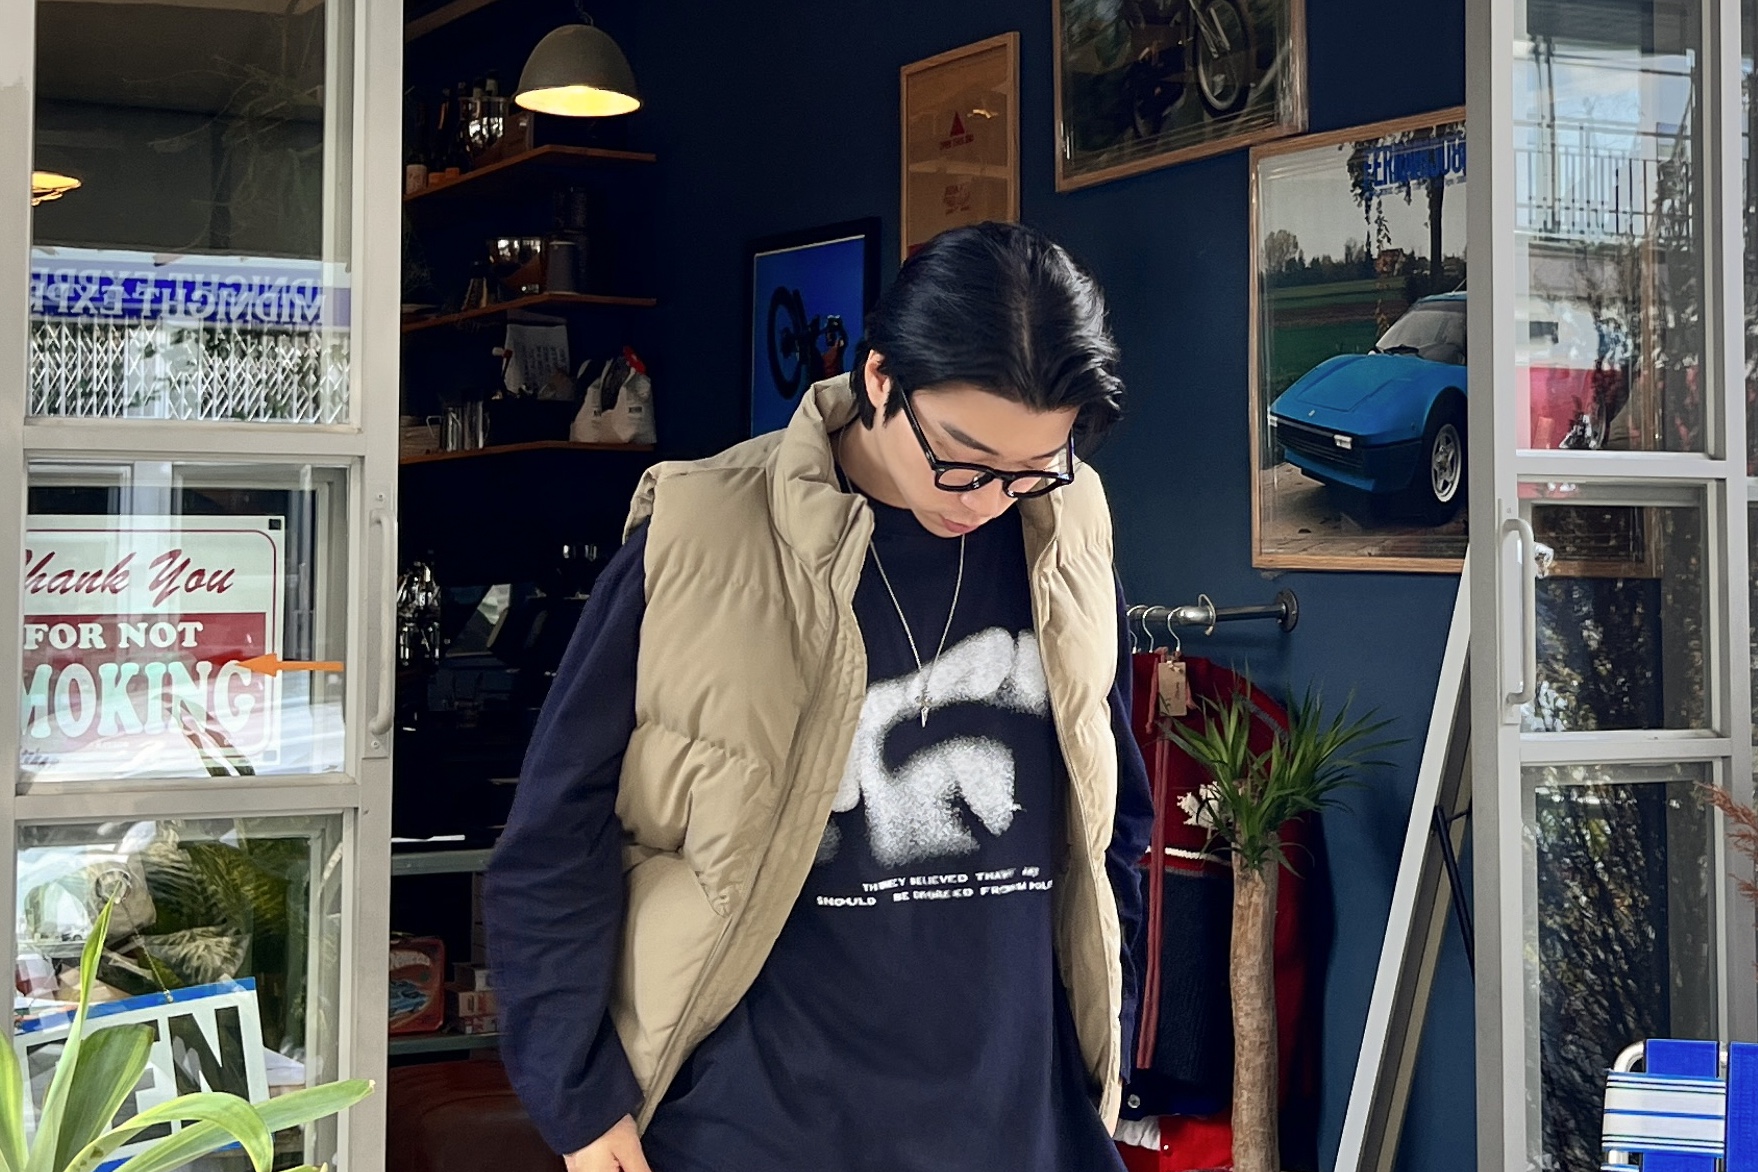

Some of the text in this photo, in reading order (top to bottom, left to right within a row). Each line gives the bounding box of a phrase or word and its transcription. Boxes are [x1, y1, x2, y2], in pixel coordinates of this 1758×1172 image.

[24, 549, 235, 608] hank You
[23, 621, 204, 650] FOR NOT
[816, 896, 877, 907] SHOULD
[892, 891, 910, 902] BE
